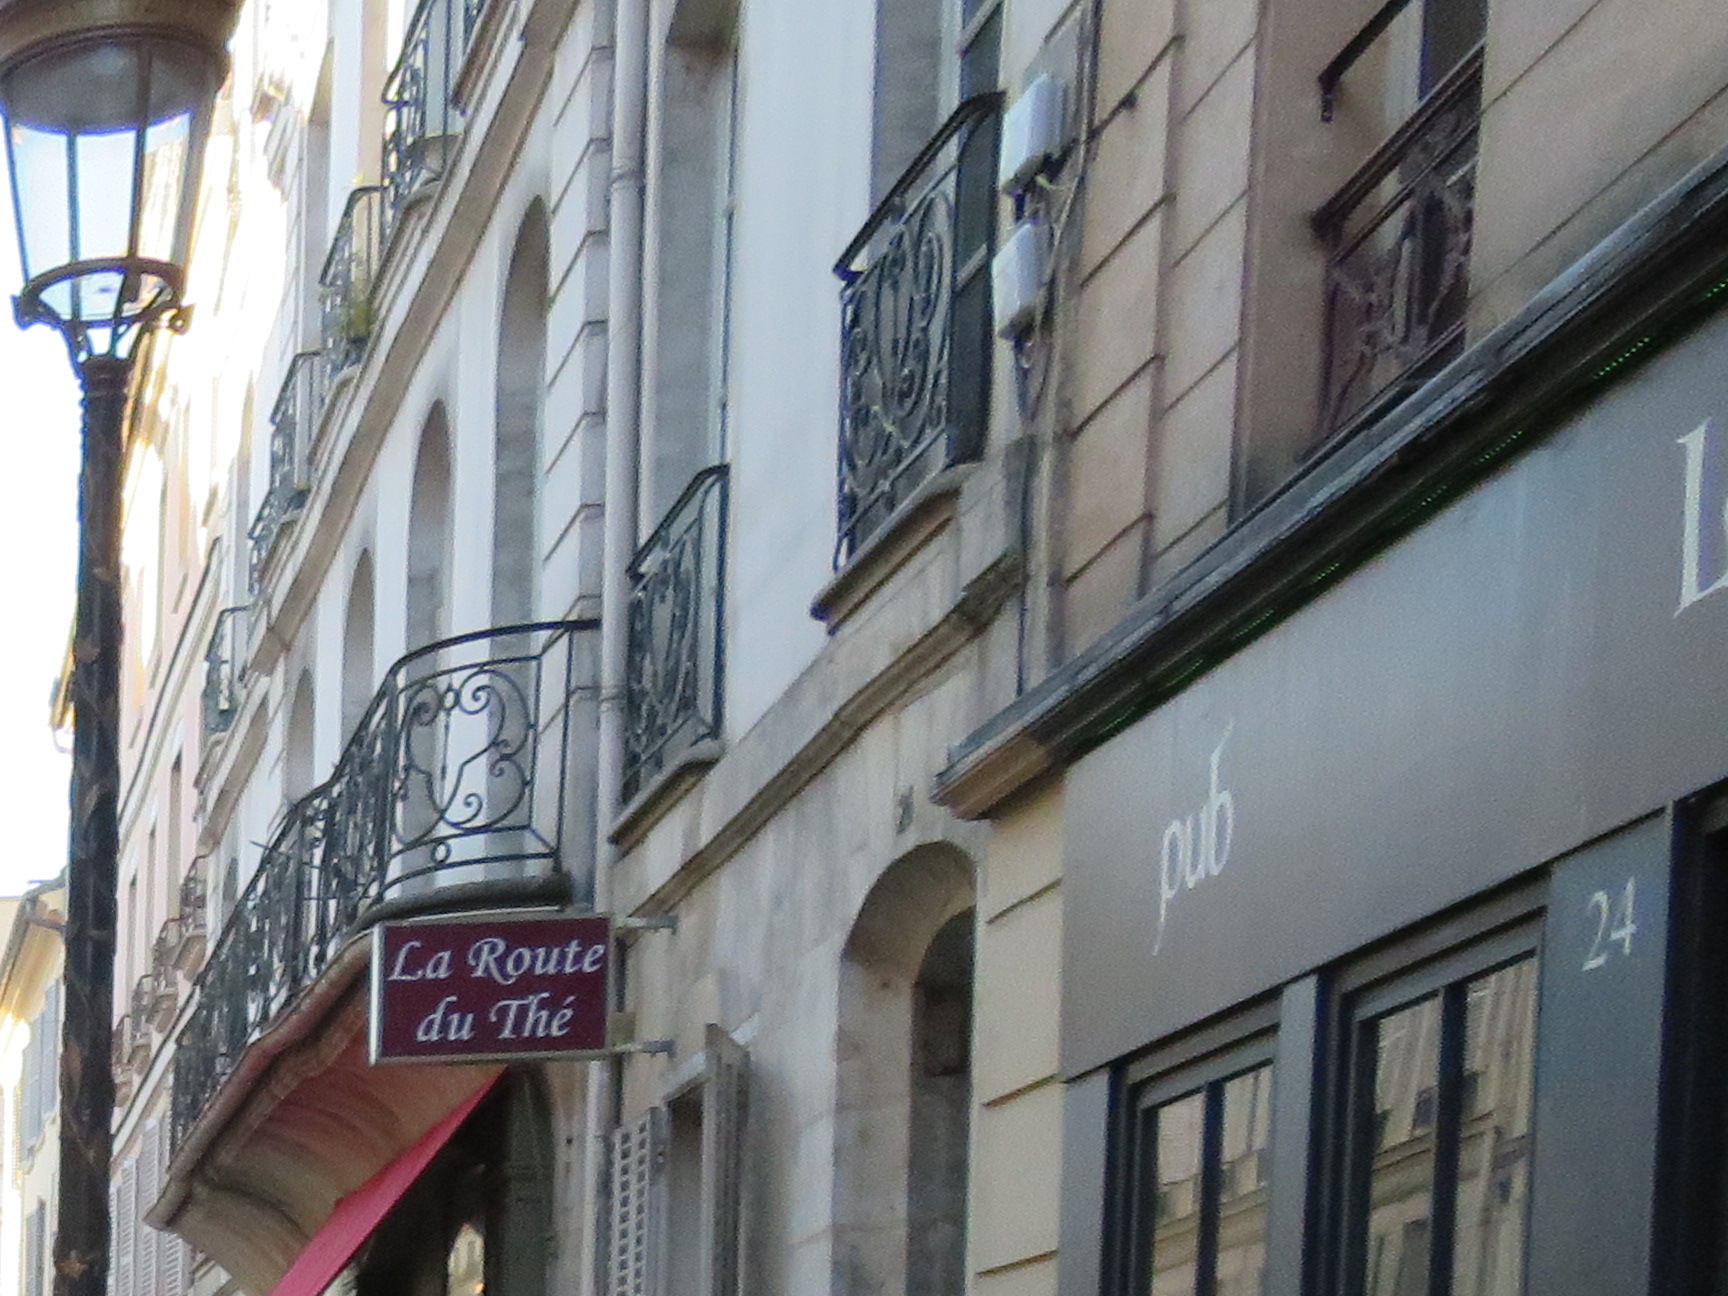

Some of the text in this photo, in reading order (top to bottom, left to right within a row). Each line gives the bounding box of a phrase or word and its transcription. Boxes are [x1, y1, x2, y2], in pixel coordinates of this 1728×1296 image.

[1152, 718, 1234, 955] pub
[1582, 876, 1636, 971] 24
[387, 937, 606, 985] La Route
[416, 992, 576, 1041] du Thé
